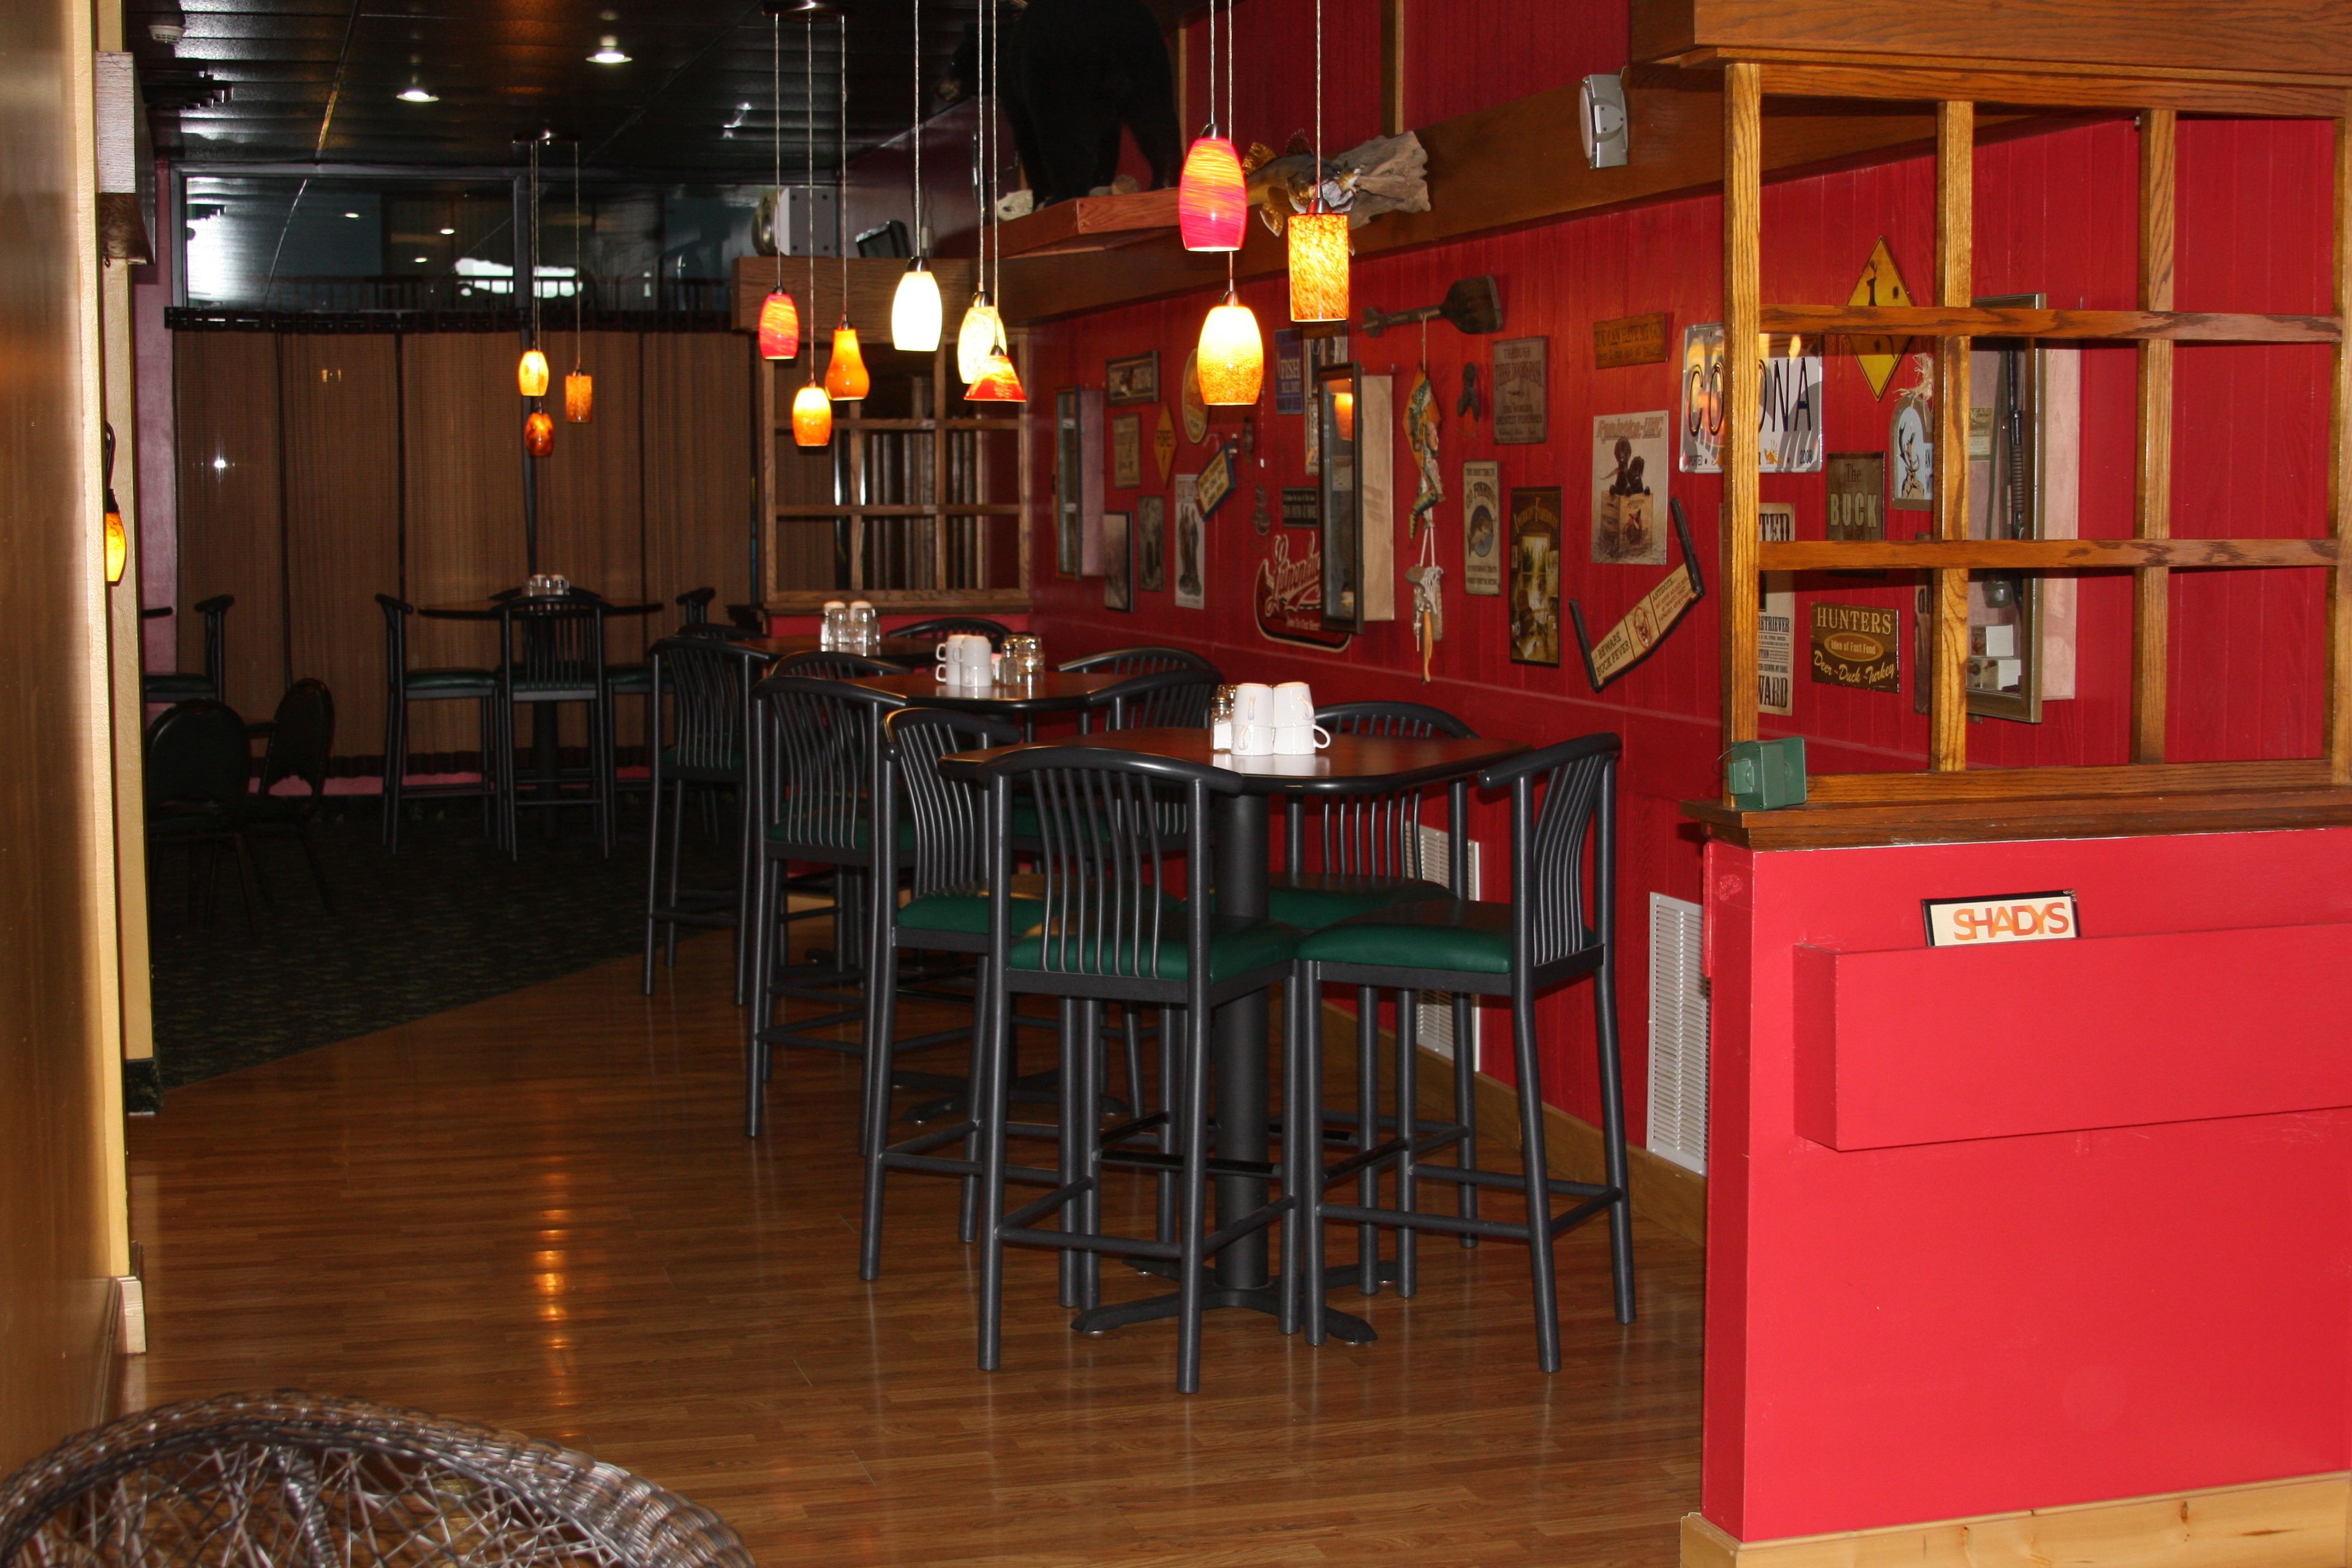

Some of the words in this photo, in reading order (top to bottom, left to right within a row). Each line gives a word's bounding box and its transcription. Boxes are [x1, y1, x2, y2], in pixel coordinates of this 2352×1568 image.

[1280, 358, 1300, 380] FISH
[1689, 358, 1811, 437] COONA
[1845, 463, 1861, 483] The
[1830, 492, 1877, 528] BUCK
[1816, 607, 1891, 635] HUNTERS
[1596, 657, 1611, 678] BUCK
[1611, 640, 1631, 663] FEVER
[1597, 631, 1622, 659] BEWARE
[1831, 639, 1843, 650] Idea
[1844, 641, 1849, 652] of
[1850, 642, 1862, 654] Fast
[1863, 643, 1875, 655] Food
[1814, 650, 1833, 676] Deer
[1953, 902, 2070, 941] SHADYS
